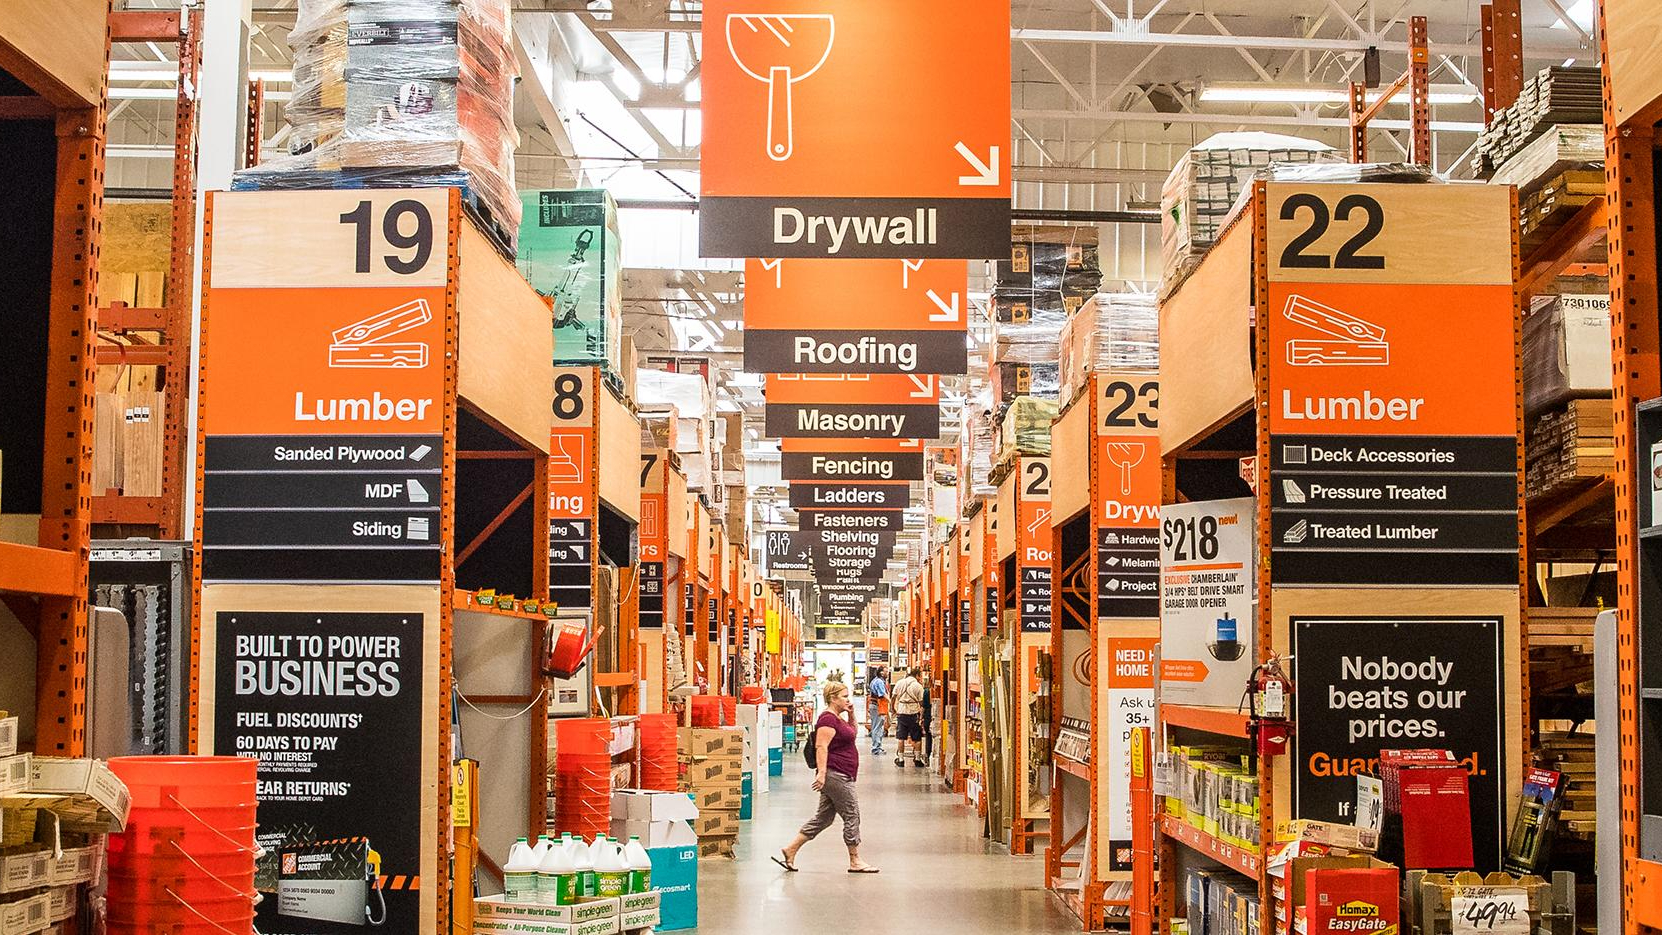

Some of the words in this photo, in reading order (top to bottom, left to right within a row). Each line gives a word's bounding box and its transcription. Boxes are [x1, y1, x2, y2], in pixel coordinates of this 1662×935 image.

[340, 200, 434, 274] 19
[773, 207, 937, 254] Drywall
[1280, 193, 1385, 270] 22
[794, 336, 917, 371] Roofing
[552, 374, 584, 420] 8
[295, 392, 432, 421] Lumber
[1105, 381, 1159, 428] 23
[1283, 390, 1424, 421] Lumber
[798, 409, 906, 436] Masonry
[274, 446, 333, 461] Sanded
[337, 446, 405, 464] Plywood
[1310, 447, 1353, 462] Deck
[1356, 448, 1455, 464] Accessories
[640, 454, 658, 488] 7
[812, 456, 894, 478] Fencing
[1026, 461, 1050, 495] 2
[365, 484, 402, 498] MDF
[814, 488, 885, 504] Ladders
[1310, 484, 1382, 500] Pressure
[1386, 485, 1447, 500] Treated
[550, 492, 583, 515] ing
[1105, 500, 1160, 522] Dryw
[814, 514, 888, 527] Fasteners
[1218, 513, 1238, 526] new!
[352, 522, 402, 539] Siding
[821, 530, 880, 545] Shelving
[1310, 524, 1372, 539] Treated
[1376, 524, 1438, 540] Lumber
[1122, 534, 1160, 544] Hardwo
[1163, 515, 1219, 562] $218
[640, 544, 658, 556] rs
[826, 545, 876, 558] Flooring
[828, 558, 872, 568] Storage
[836, 570, 862, 578] Rugs
[1038, 571, 1052, 579] Flas
[754, 582, 762, 596] 0
[1122, 580, 1157, 592] Project
[1188, 586, 1198, 596] BELT
[1200, 585, 1220, 596] DRIVE
[1221, 584, 1244, 596] SMART
[828, 593, 864, 602] Plumbing
[1164, 598, 1185, 609] GARAGE
[1185, 598, 1198, 608] DOOR
[1200, 598, 1227, 608] OPENER
[236, 635, 292, 657] BUILT
[296, 636, 323, 658] TO
[328, 636, 400, 658] POWER
[1116, 650, 1145, 662] NEED
[1116, 664, 1149, 676] HOME
[1341, 656, 1454, 686] Nobody
[235, 660, 401, 697] BUSINESS
[1120, 697, 1144, 708] Ask
[1148, 700, 1154, 708] u
[1328, 685, 1409, 710] beats
[1417, 690, 1466, 709] our
[236, 712, 272, 728] FUEL
[1126, 713, 1150, 724] 35+
[1349, 714, 1446, 744] prices.
[236, 736, 253, 750] 60
[256, 736, 290, 750] DAYS
[292, 736, 310, 750] TO
[313, 736, 338, 750] PAY
[260, 752, 272, 761] NO
[274, 752, 313, 762] INTEREST
[1308, 752, 1487, 777] Guard.
[256, 781, 282, 795] EAR
[1338, 802, 1350, 816] If
[298, 854, 332, 862] COMMERCIAL
[680, 851, 694, 860] LED
[298, 863, 322, 871] ACCOUNT
[600, 877, 622, 885] simple
[600, 884, 622, 892] green
[660, 883, 691, 893] ecosmart
[496, 906, 512, 914] Keeps
[514, 907, 526, 915] Your
[528, 908, 544, 916] World
[545, 908, 561, 917] Clean
[1340, 904, 1376, 916] Homax
[473, 921, 508, 930] Concentrated
[513, 922, 545, 932] All-Purpose
[546, 924, 568, 934] Cleaner
[1328, 918, 1387, 931] EasyGate
